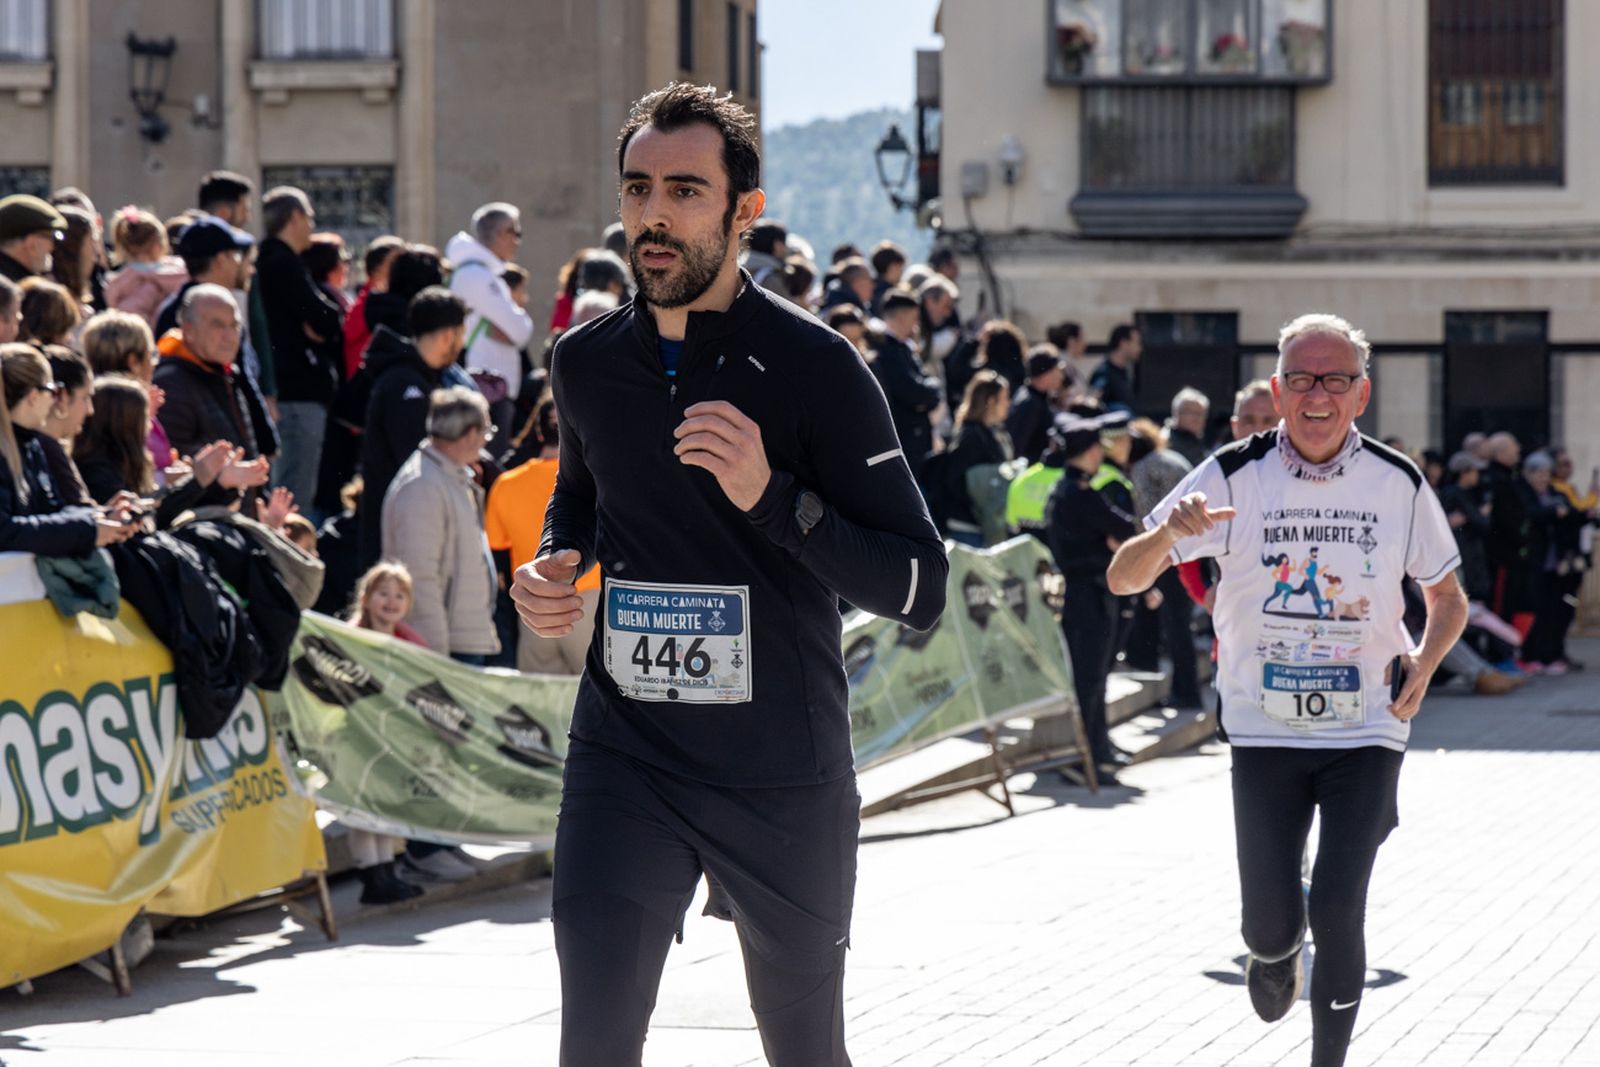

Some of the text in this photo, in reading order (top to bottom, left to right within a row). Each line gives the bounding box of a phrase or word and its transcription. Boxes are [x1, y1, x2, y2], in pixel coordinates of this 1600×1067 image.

[1262, 508, 1378, 523] VI CARRERA CAMINATA
[1303, 525, 1355, 544] MUERTE
[617, 593, 726, 609] VI CARRERA CAMINATA
[617, 609, 702, 630] BUENA MUERTE
[631, 635, 712, 678] 446
[1298, 678, 1334, 690] MUERTE
[1293, 692, 1327, 717] 10
